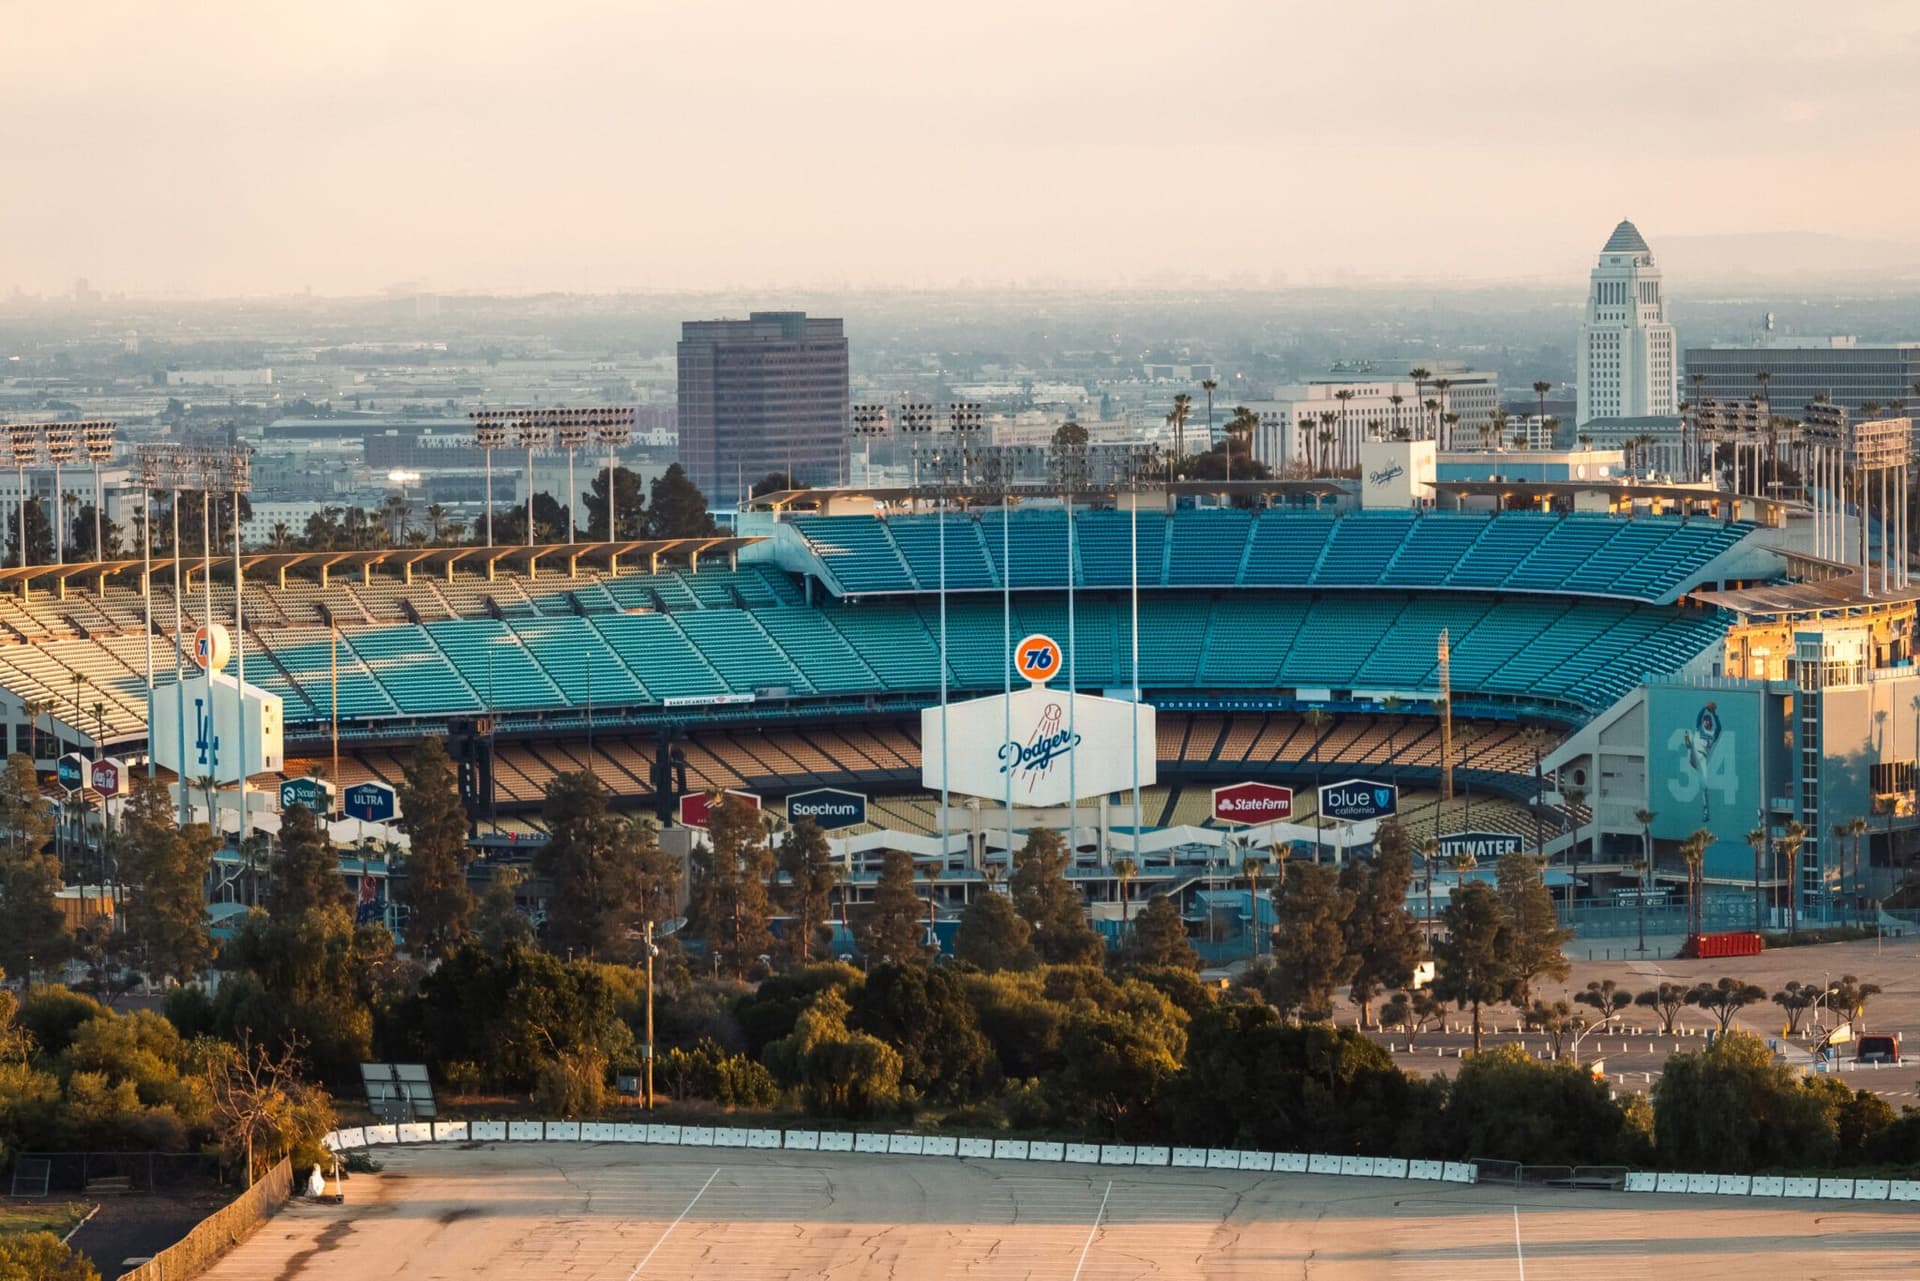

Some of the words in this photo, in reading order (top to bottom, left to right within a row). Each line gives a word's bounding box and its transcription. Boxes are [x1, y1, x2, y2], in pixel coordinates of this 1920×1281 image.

[1025, 647, 1053, 669] 76
[1667, 728, 1739, 805] 34
[354, 794, 384, 805] ULTRA
[1328, 789, 1370, 807] blue
[792, 803, 856, 815] Spectrum
[1335, 806, 1375, 815] california
[1438, 840, 1515, 856] UTWATER
